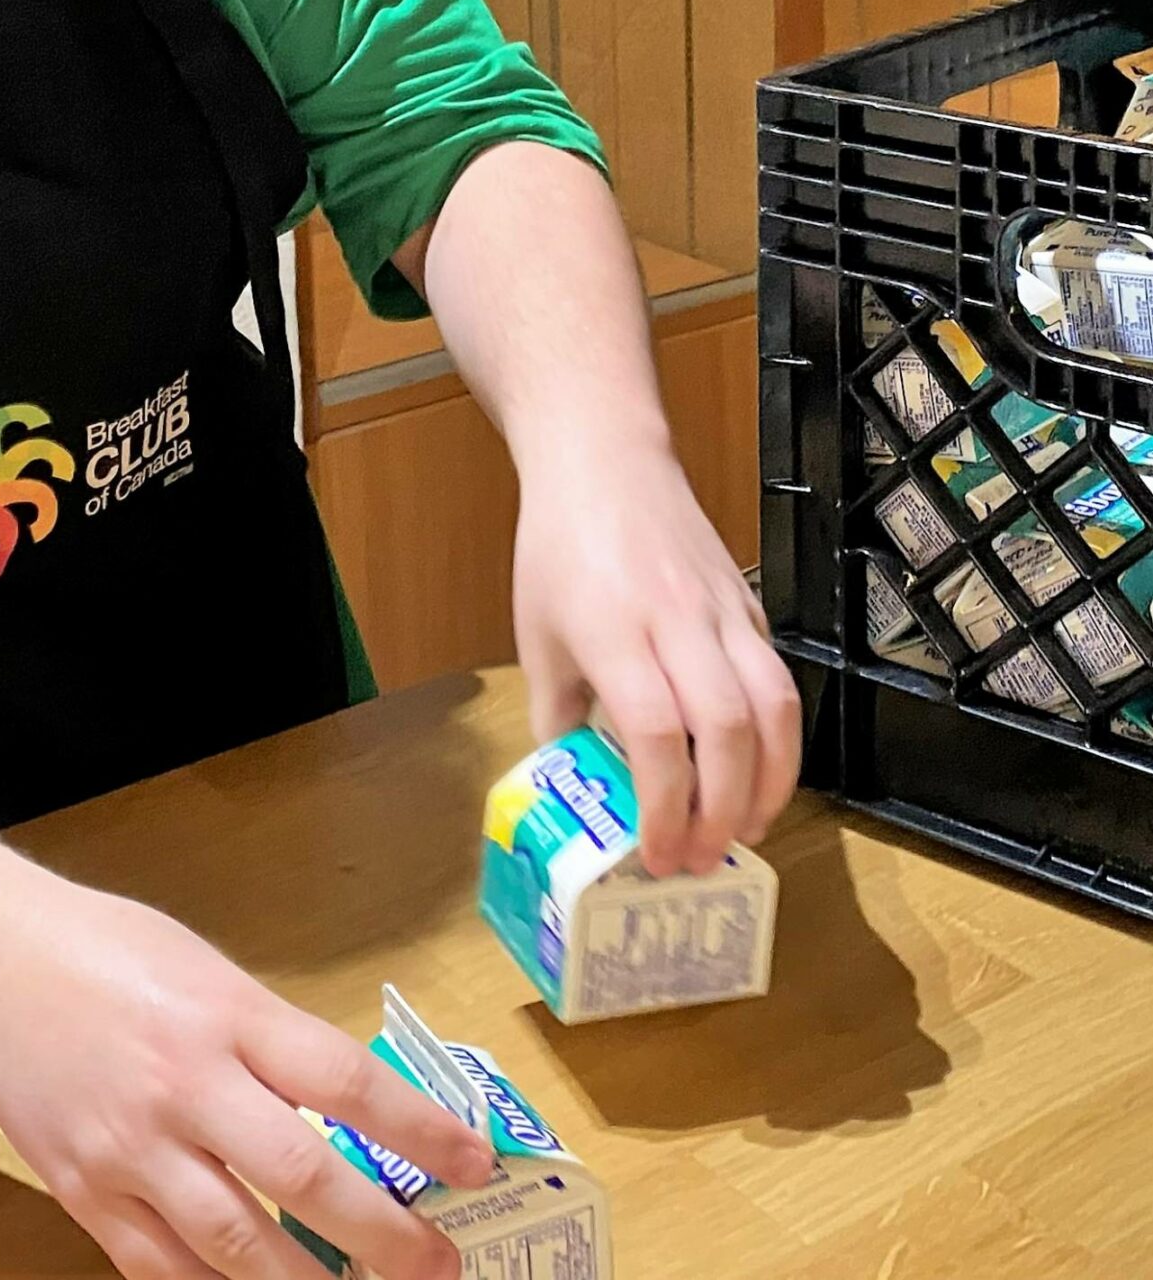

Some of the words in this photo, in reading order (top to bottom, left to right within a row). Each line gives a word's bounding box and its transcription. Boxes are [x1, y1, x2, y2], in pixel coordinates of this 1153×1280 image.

[85, 396, 190, 489] CLUB
[86, 369, 189, 450] Breakfast
[85, 487, 110, 516] of
[115, 438, 193, 500] Canada
